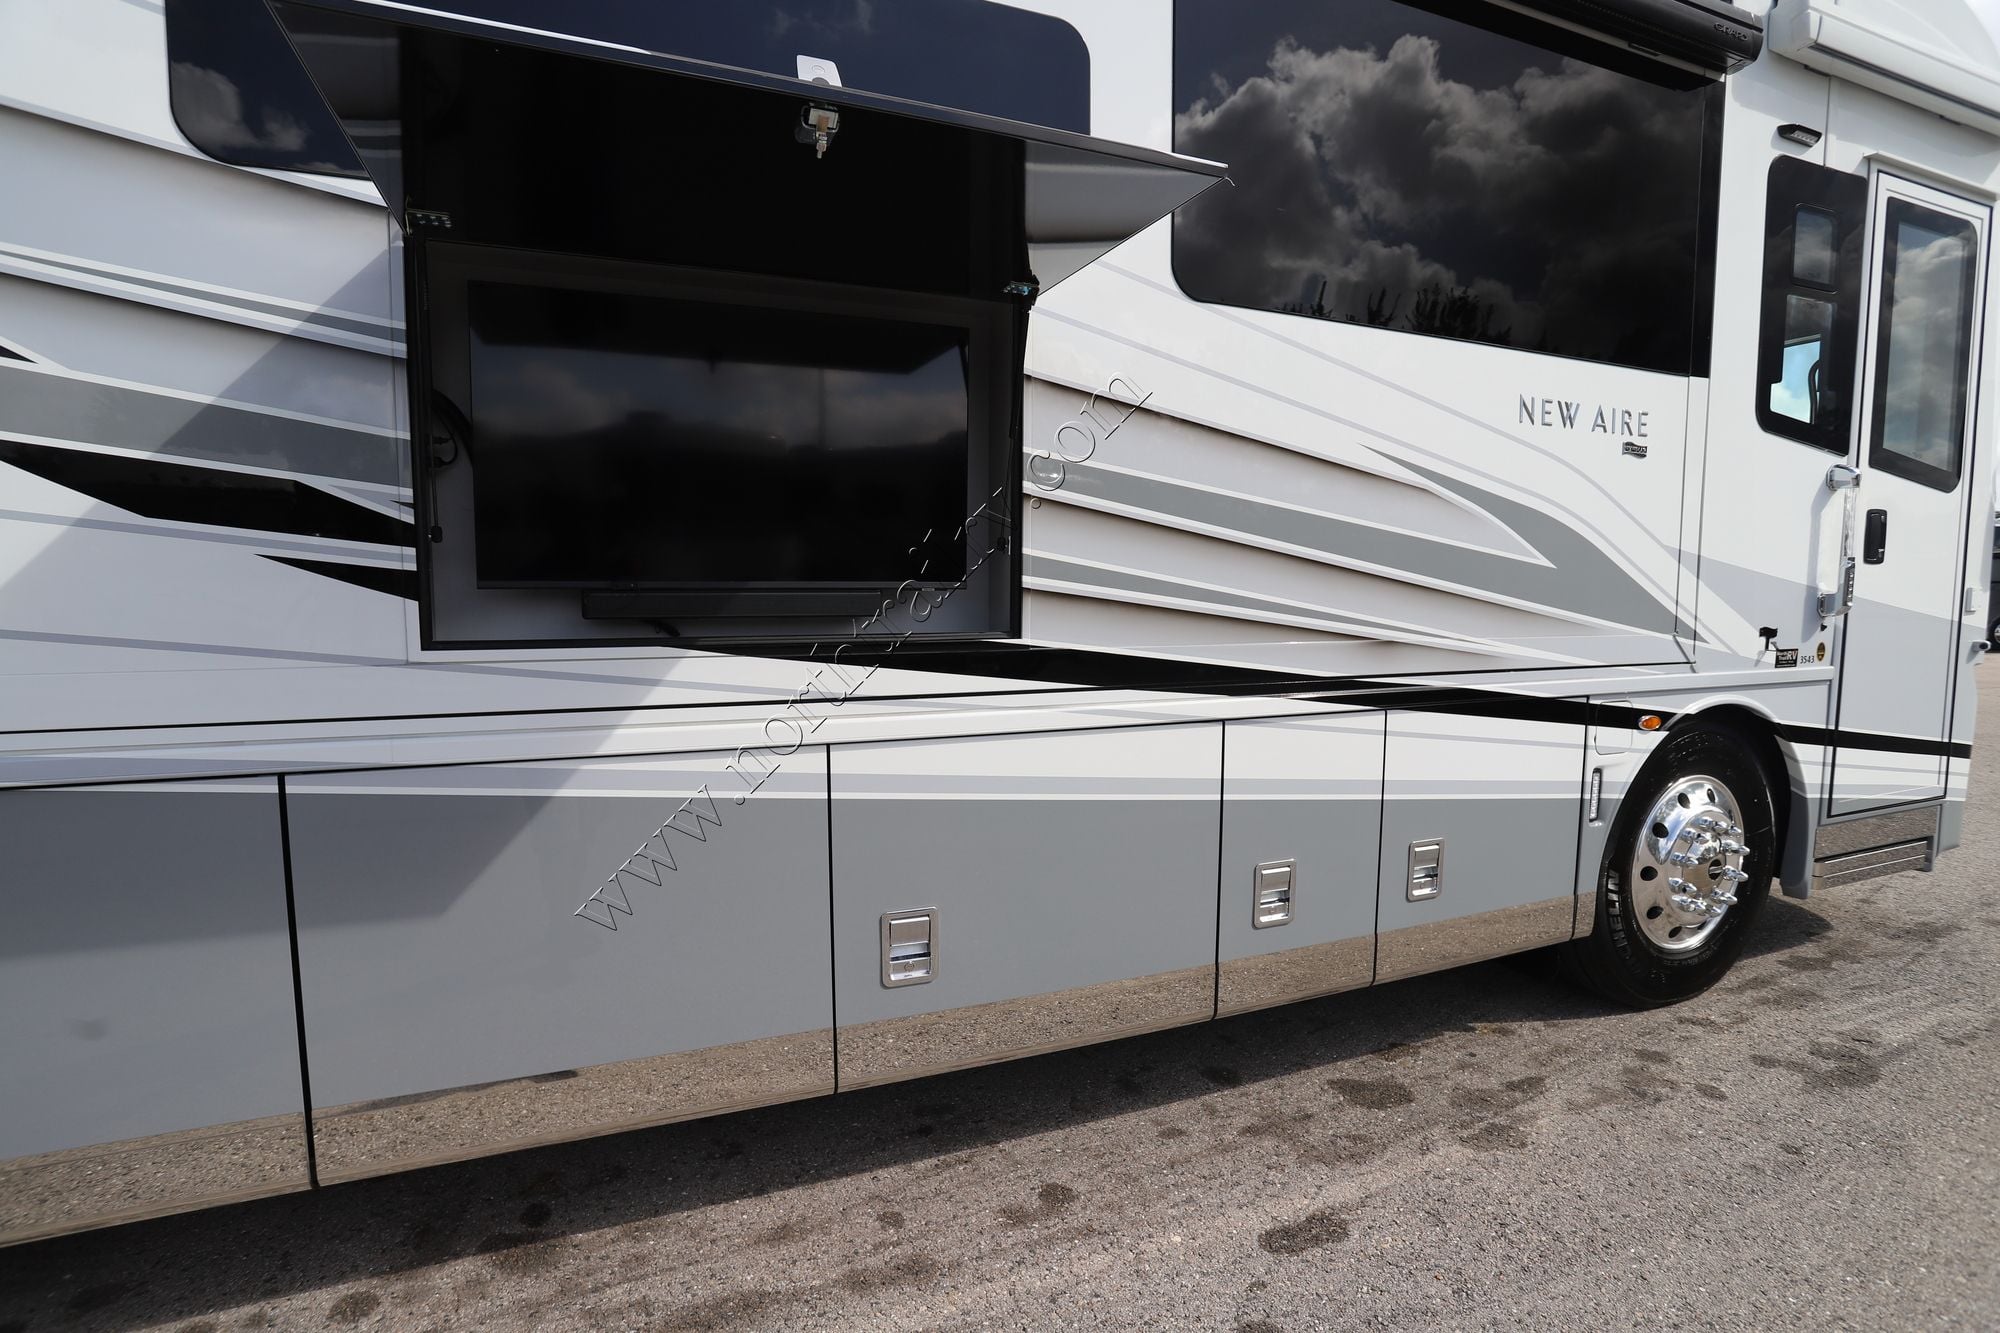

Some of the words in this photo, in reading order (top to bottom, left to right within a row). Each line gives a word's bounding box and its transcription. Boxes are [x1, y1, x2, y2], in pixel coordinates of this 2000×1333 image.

[1519, 393, 1580, 430] NEW
[1591, 403, 1649, 438] AIRE
[1787, 650, 1798, 661] RV
[1800, 655, 1815, 664] 3543
